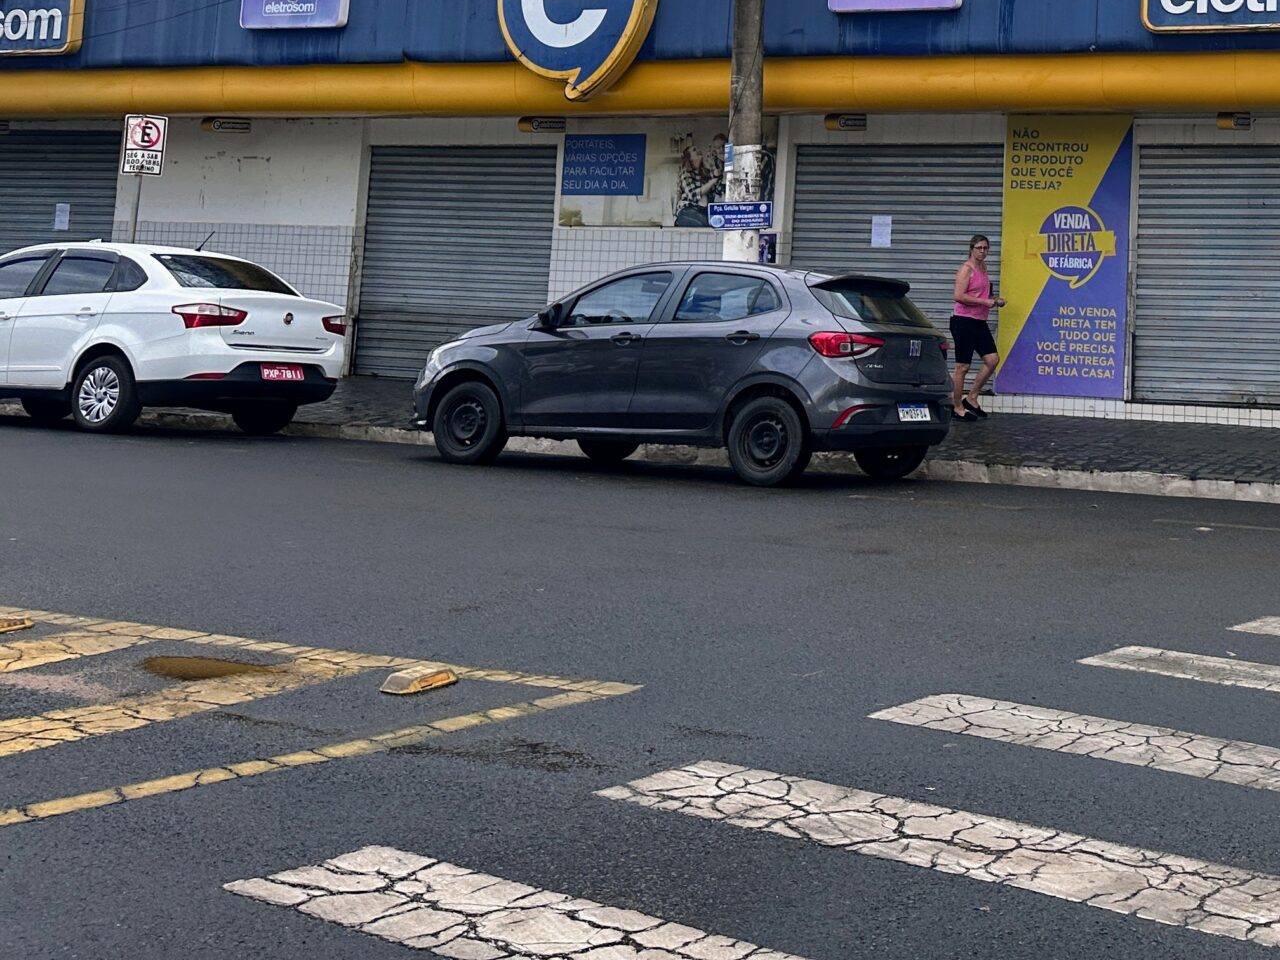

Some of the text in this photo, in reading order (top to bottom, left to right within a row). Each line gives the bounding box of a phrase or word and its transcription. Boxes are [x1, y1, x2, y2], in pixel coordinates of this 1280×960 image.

[265, 1, 314, 14] eletrosom
[1012, 128, 1039, 139] NÃO
[1012, 143, 1088, 152] ENCONTROU
[565, 151, 638, 164] VÁRIAS OPÇÕES
[1011, 155, 1083, 165] O PRODUTO
[564, 167, 635, 176] PARA FACILITAR
[1011, 166, 1073, 177] QUE VOCÊ
[563, 180, 629, 189] SEU DIA A DIA.
[1010, 180, 1062, 190] DESEJA?
[1053, 213, 1091, 229] VENDA
[1047, 232, 1096, 252] DIRETA
[1049, 254, 1093, 269] DE FÁBRICA
[1059, 306, 1116, 317] NO VENDA
[1052, 318, 1116, 329] DIRETA TEM
[1059, 330, 1116, 342] TUDO QUE
[1036, 341, 1115, 354] VOCÊ PRECISA
[1036, 354, 1115, 366] COM ENTREGA
[263, 368, 301, 379] PXP-7811
[1038, 366, 1115, 379] EM SUA CASA!
